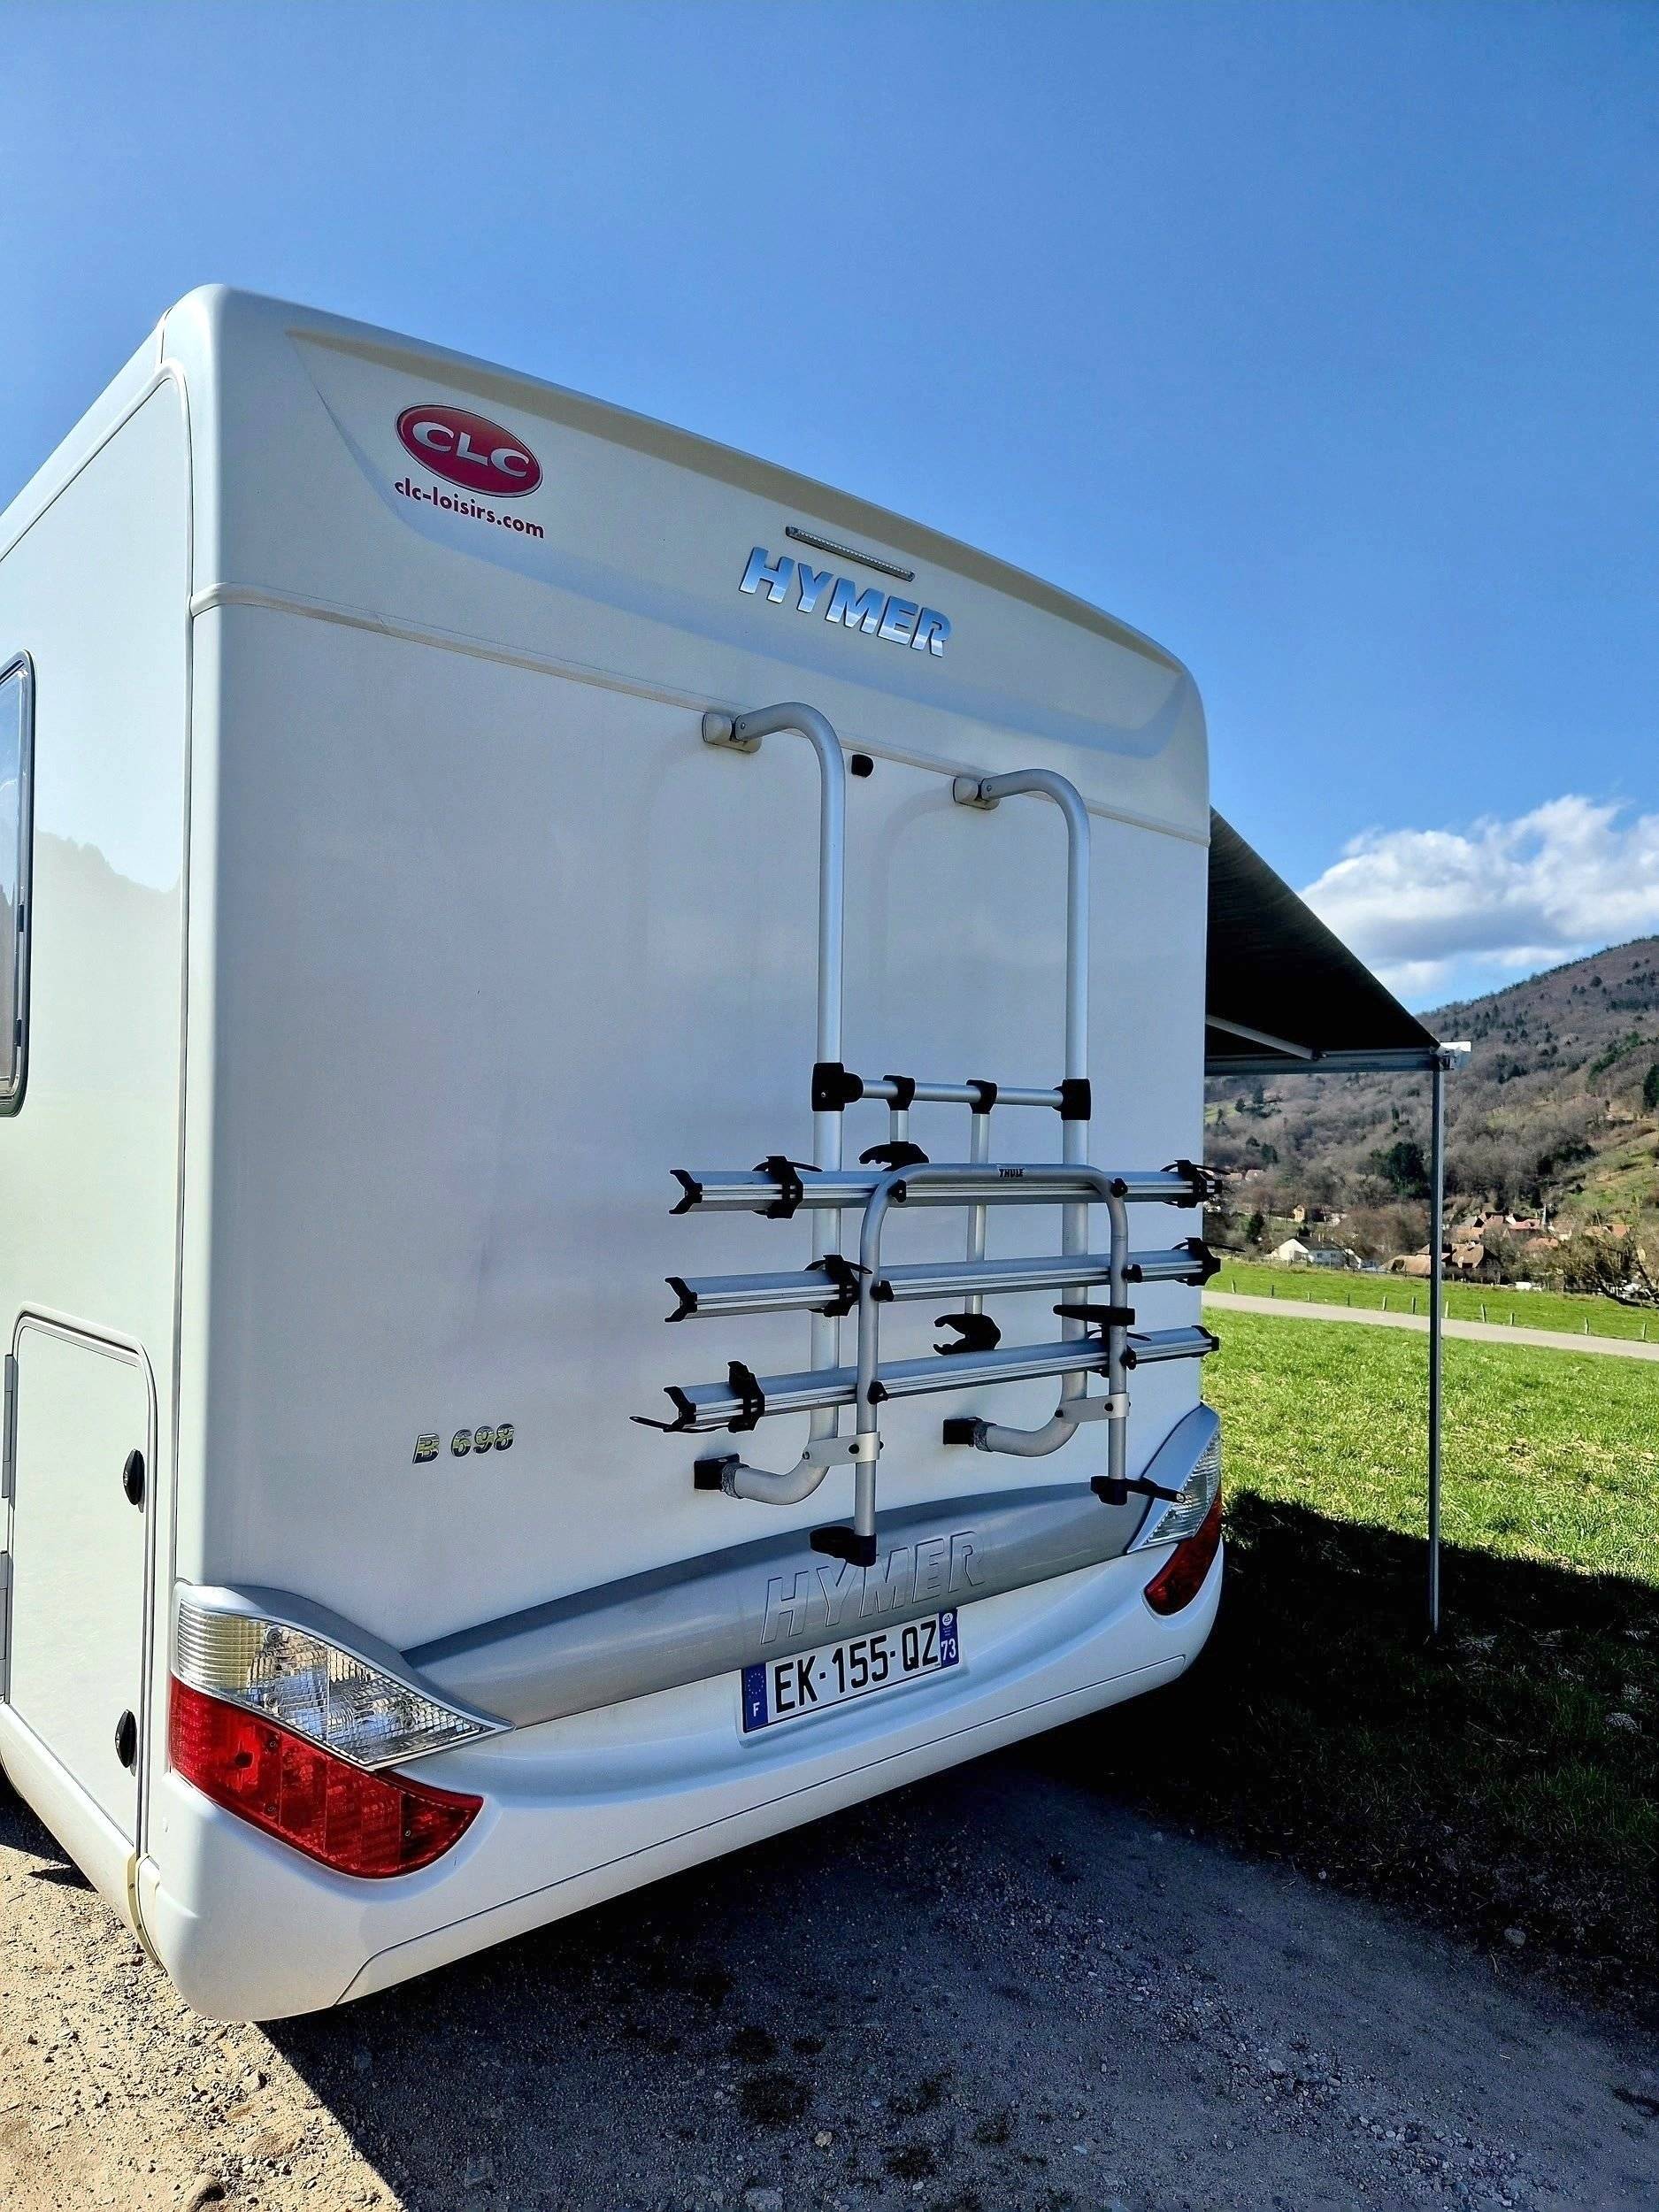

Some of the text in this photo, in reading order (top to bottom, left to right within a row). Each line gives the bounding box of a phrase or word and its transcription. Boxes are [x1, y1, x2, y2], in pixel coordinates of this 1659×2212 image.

[412, 421, 529, 478] CLC
[394, 477, 544, 539] clc-loisirs.com
[739, 546, 952, 657] HYMER
[998, 1168, 1025, 1178] THULE
[412, 1423, 515, 1464] B 698
[760, 1531, 986, 1645] HYMER
[941, 1638, 956, 1661] 73
[753, 1701, 760, 1717] F
